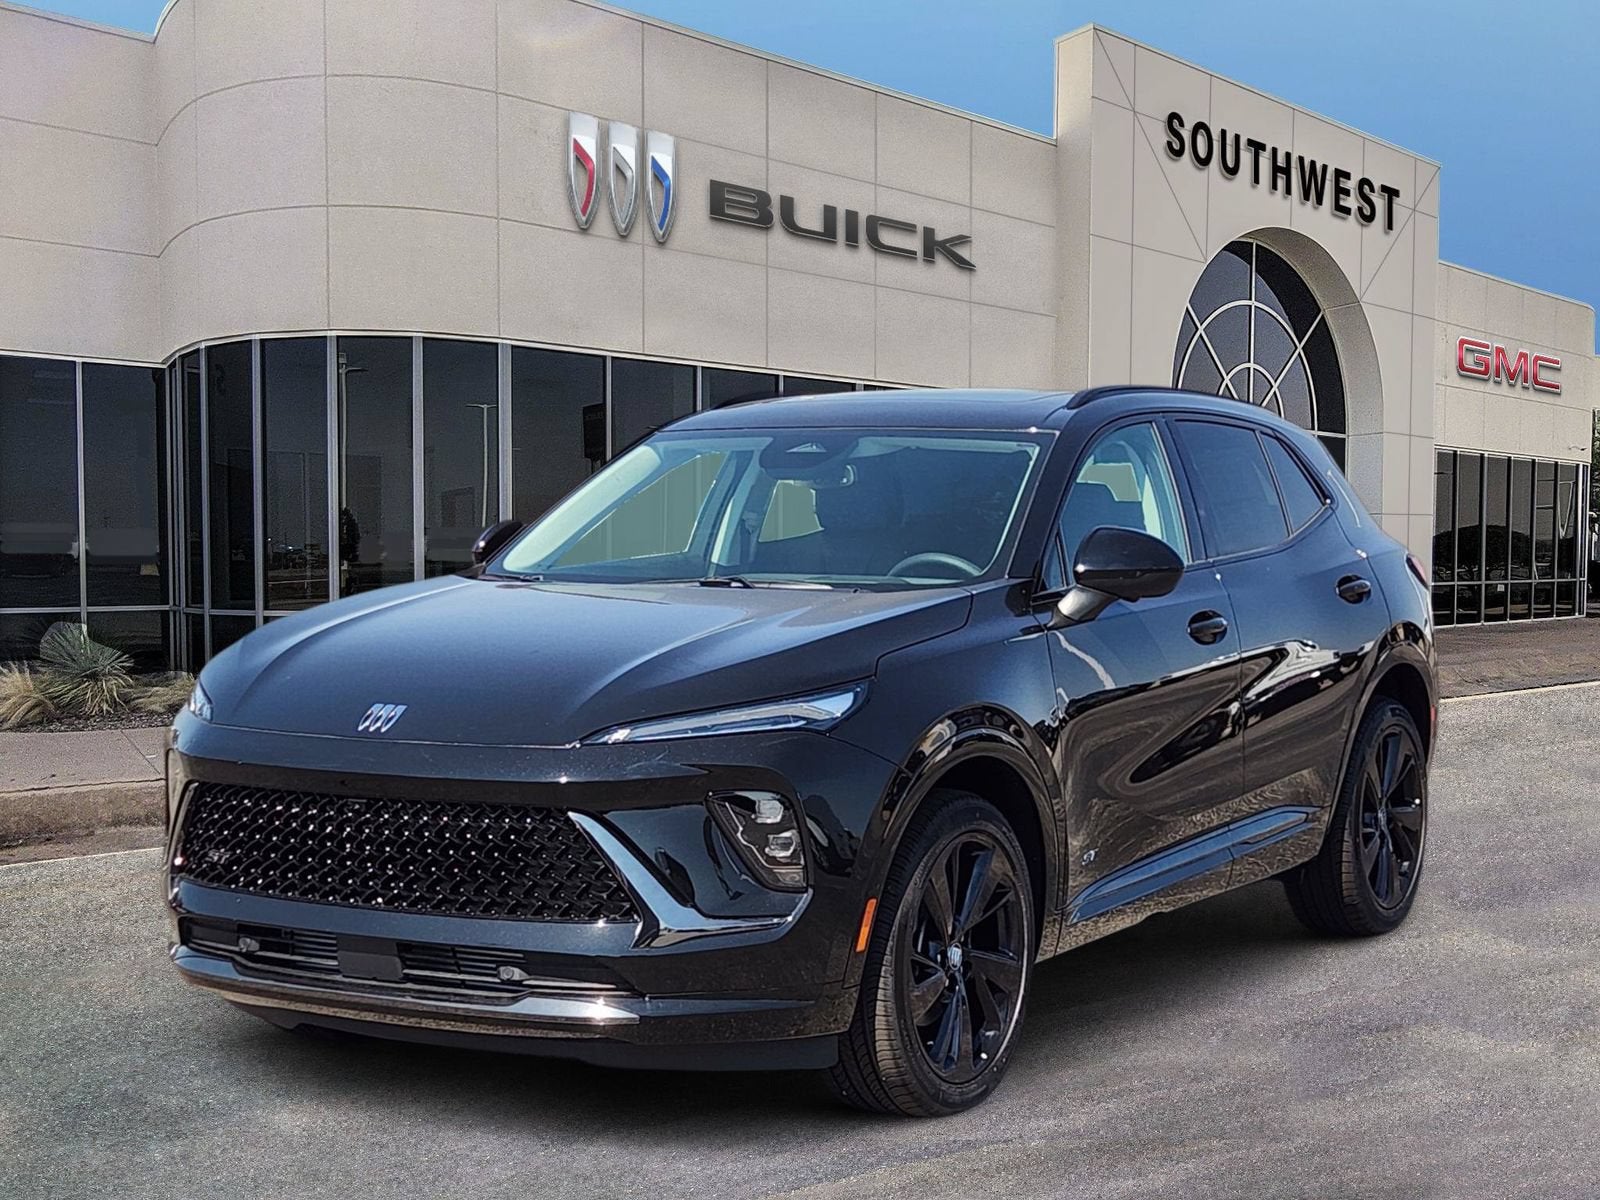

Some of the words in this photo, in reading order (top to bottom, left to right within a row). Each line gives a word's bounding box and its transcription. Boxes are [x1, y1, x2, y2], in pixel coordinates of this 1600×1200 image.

[1166, 111, 1400, 232] SOUTHWEST
[709, 179, 977, 270] BUICK
[1457, 336, 1562, 394] GMC
